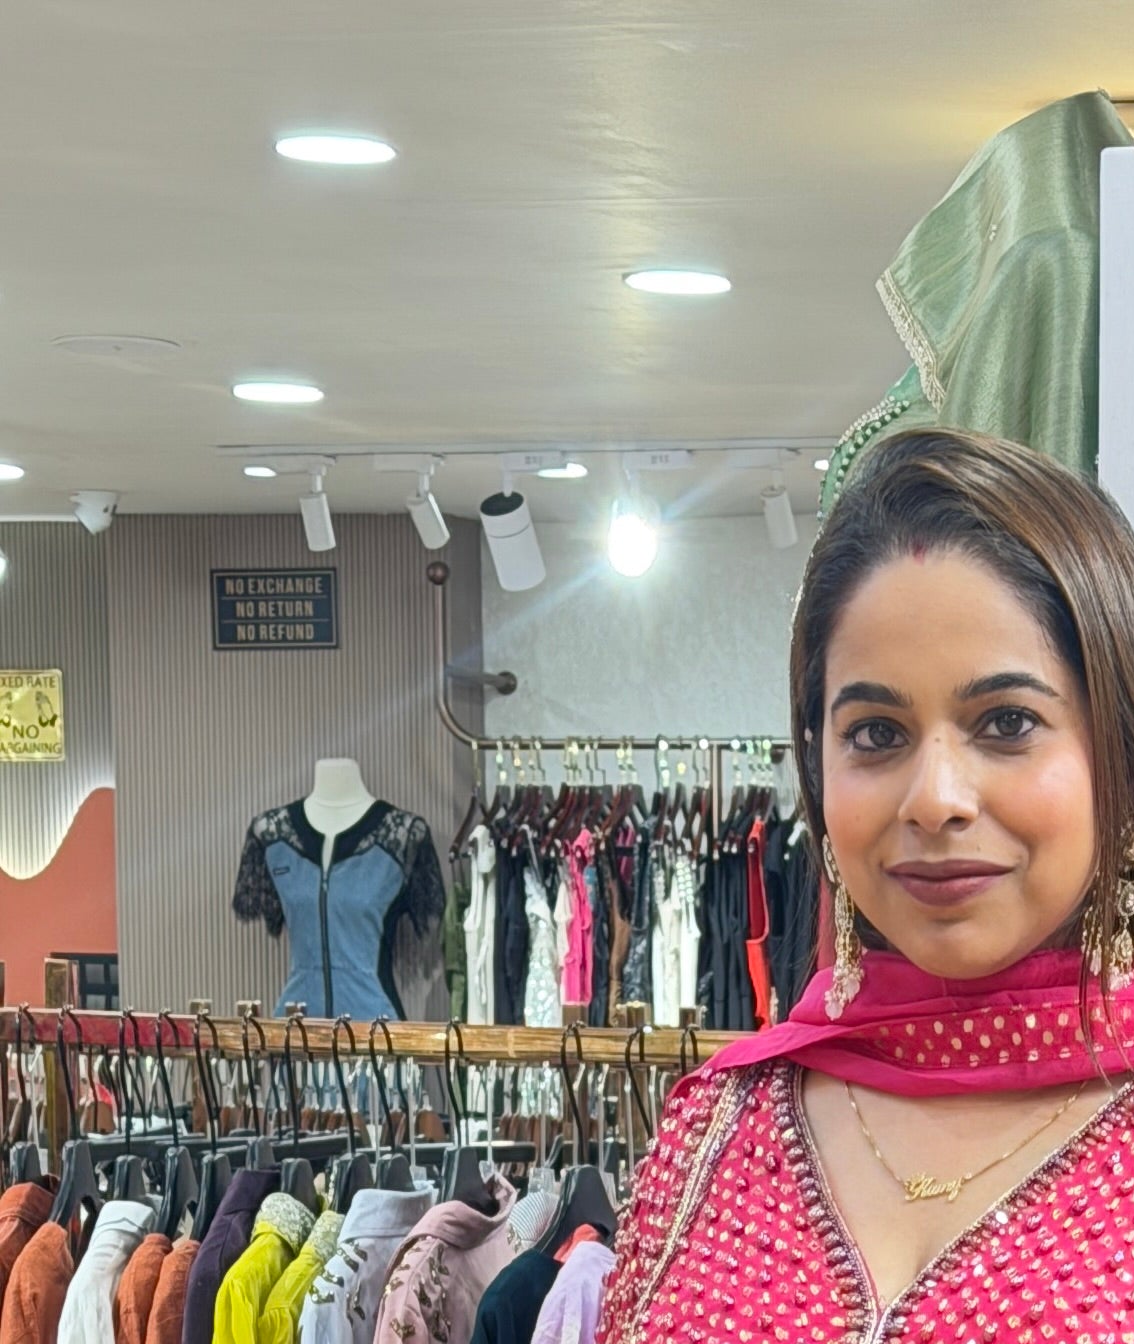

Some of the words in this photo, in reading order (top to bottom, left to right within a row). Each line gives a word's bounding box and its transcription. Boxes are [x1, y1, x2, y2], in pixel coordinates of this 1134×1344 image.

[225, 578, 244, 595] NO
[248, 577, 323, 594] EXCHANGE
[235, 601, 255, 617] NO
[258, 600, 314, 617] RETURN
[237, 624, 255, 641] NO
[259, 623, 315, 640] REFUND
[27, 676, 55, 688] RATE
[13, 724, 39, 738] NO
